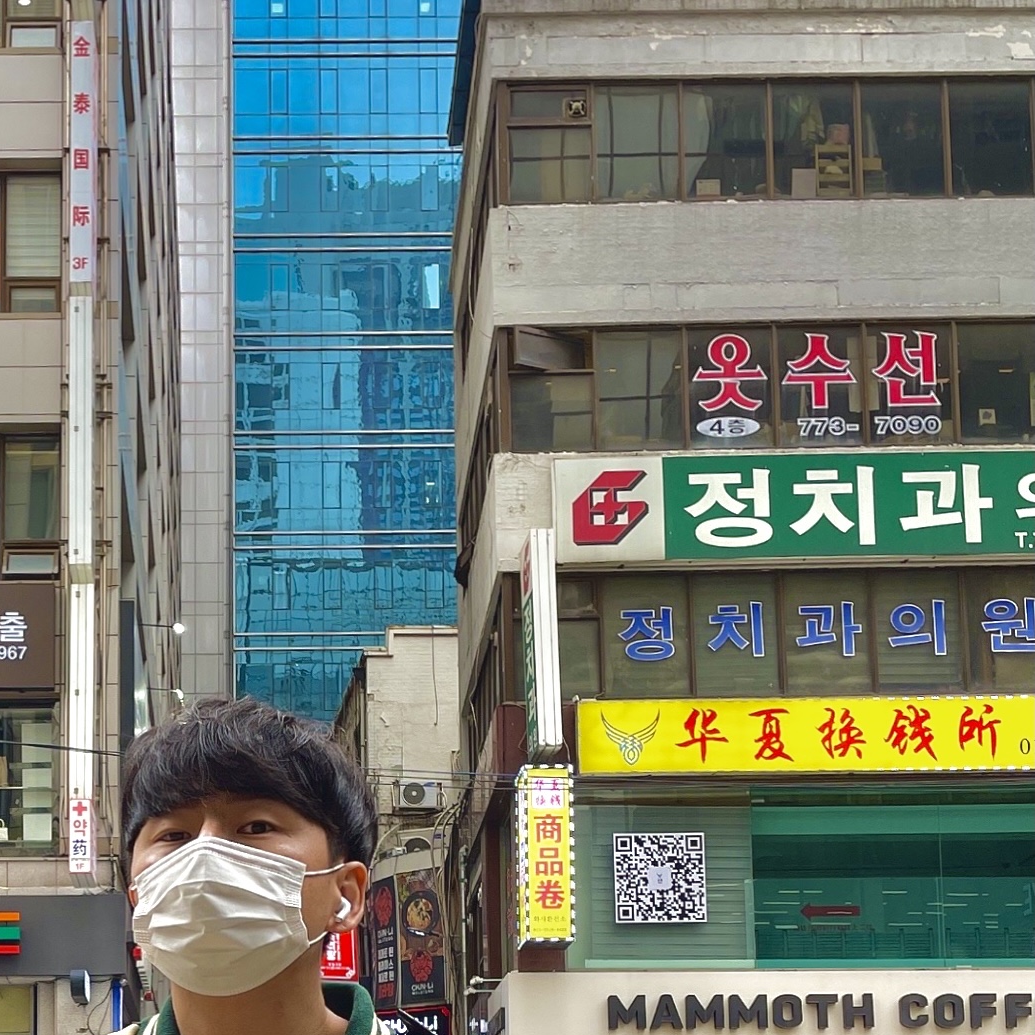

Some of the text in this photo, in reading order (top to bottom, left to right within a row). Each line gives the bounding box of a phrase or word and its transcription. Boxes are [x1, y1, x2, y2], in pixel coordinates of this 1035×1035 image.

[73, 36, 90, 227] 金泰国际
[72, 257, 88, 270] 3F
[692, 331, 941, 412] 옷수선
[709, 418, 746, 436] 4층
[874, 415, 942, 435] 7090
[607, 992, 1033, 1030] MAMMOTH COFF
